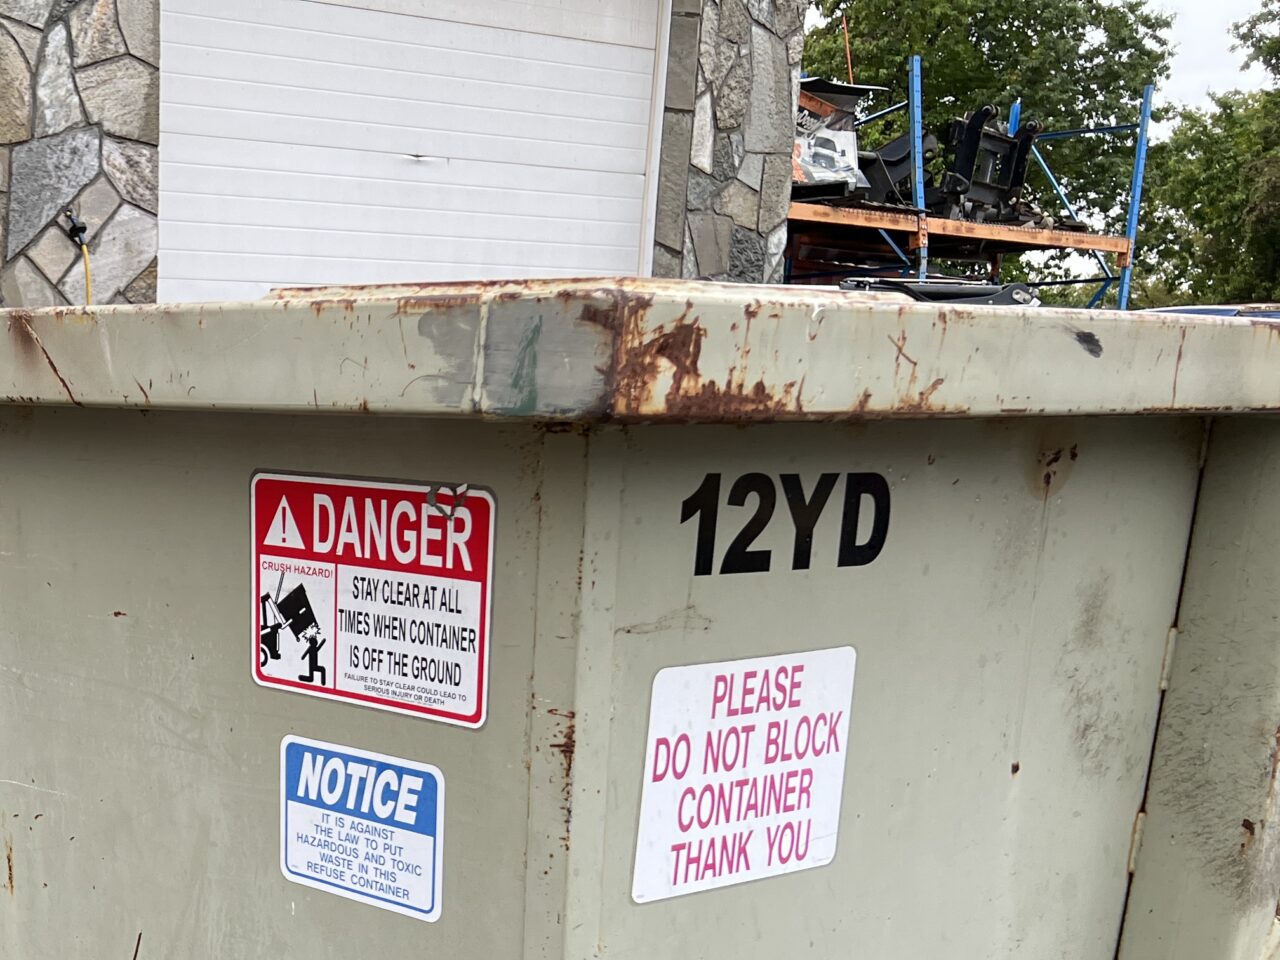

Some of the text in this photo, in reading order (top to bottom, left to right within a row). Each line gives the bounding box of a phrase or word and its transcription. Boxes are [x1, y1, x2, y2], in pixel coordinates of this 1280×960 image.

[313, 493, 473, 572] DANGER
[680, 472, 891, 577] 12YD
[261, 561, 333, 579] CRUSH HAZARD!
[352, 576, 462, 614] STAY CLEAR AT ALL
[338, 608, 476, 654] TIMES WHEN CONTAINER
[344, 672, 369, 683] FAILURE
[370, 677, 378, 685] TO
[379, 679, 394, 688] STAY
[395, 682, 415, 692] CLEAR
[417, 686, 438, 696] COULD
[440, 690, 457, 700] LEAD
[458, 694, 467, 702] TO
[349, 645, 462, 687] IS OFF THE GROUND
[364, 684, 389, 695] SERIOUS
[391, 689, 412, 699] INJURY
[424, 696, 445, 705] DEATH
[711, 664, 804, 719] PLEASE
[652, 711, 843, 783] DO NOT BLOCK
[297, 752, 423, 825] NOTICE
[677, 768, 813, 833] CONTAINER
[314, 824, 404, 857] THE LAW TO PUT
[321, 813, 395, 841] IT IS AGAINST
[296, 832, 422, 877] HAZARDOUS AND TOXIC
[319, 852, 397, 883] WASTE IN THIS
[670, 819, 812, 886] THANK YOU
[307, 861, 410, 900] REFUSE CONTAINER
